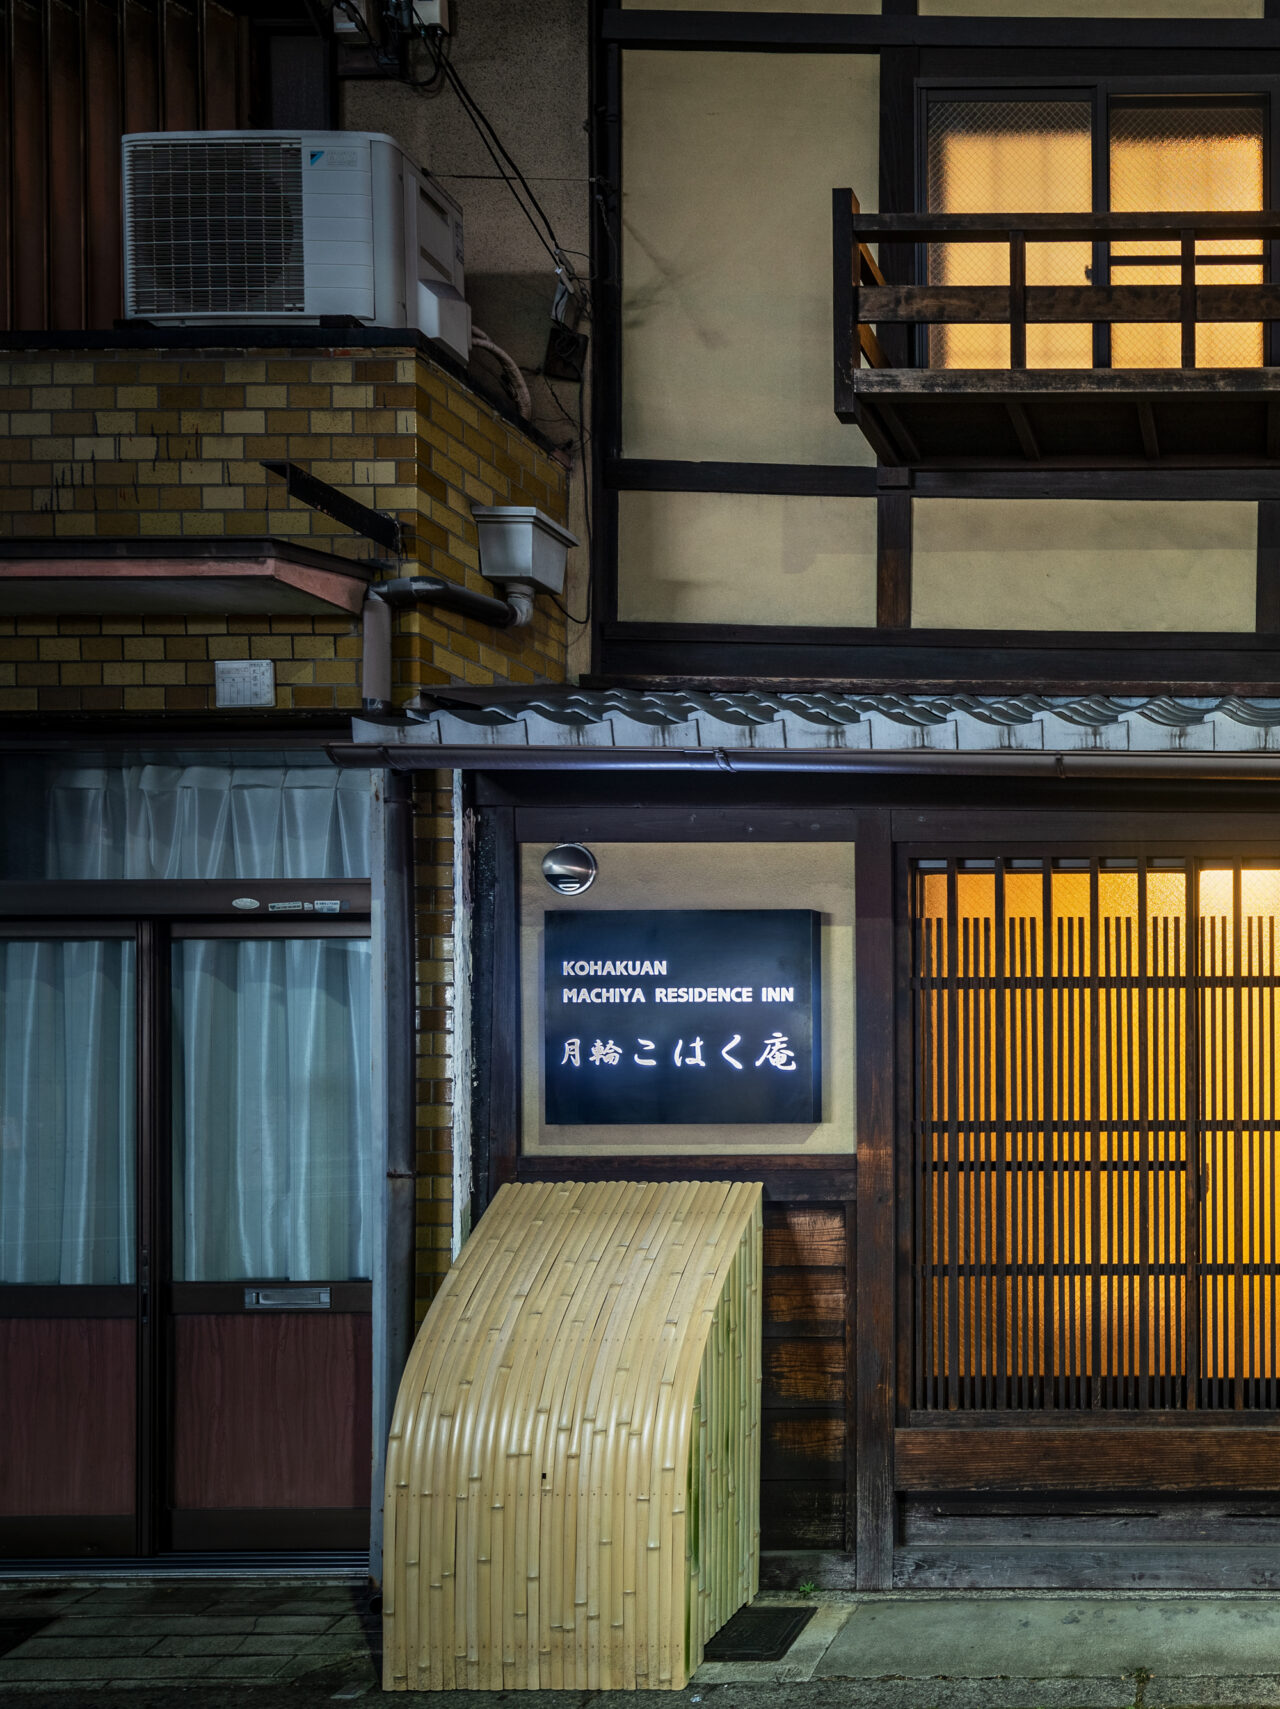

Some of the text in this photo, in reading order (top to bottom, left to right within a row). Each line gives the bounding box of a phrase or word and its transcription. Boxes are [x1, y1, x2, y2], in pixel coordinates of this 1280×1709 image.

[562, 960, 668, 976] KOHAKUAN
[562, 986, 795, 1003] MACHIYA RESIDENCE INN
[561, 1032, 797, 1071] 月輪こはく庵
